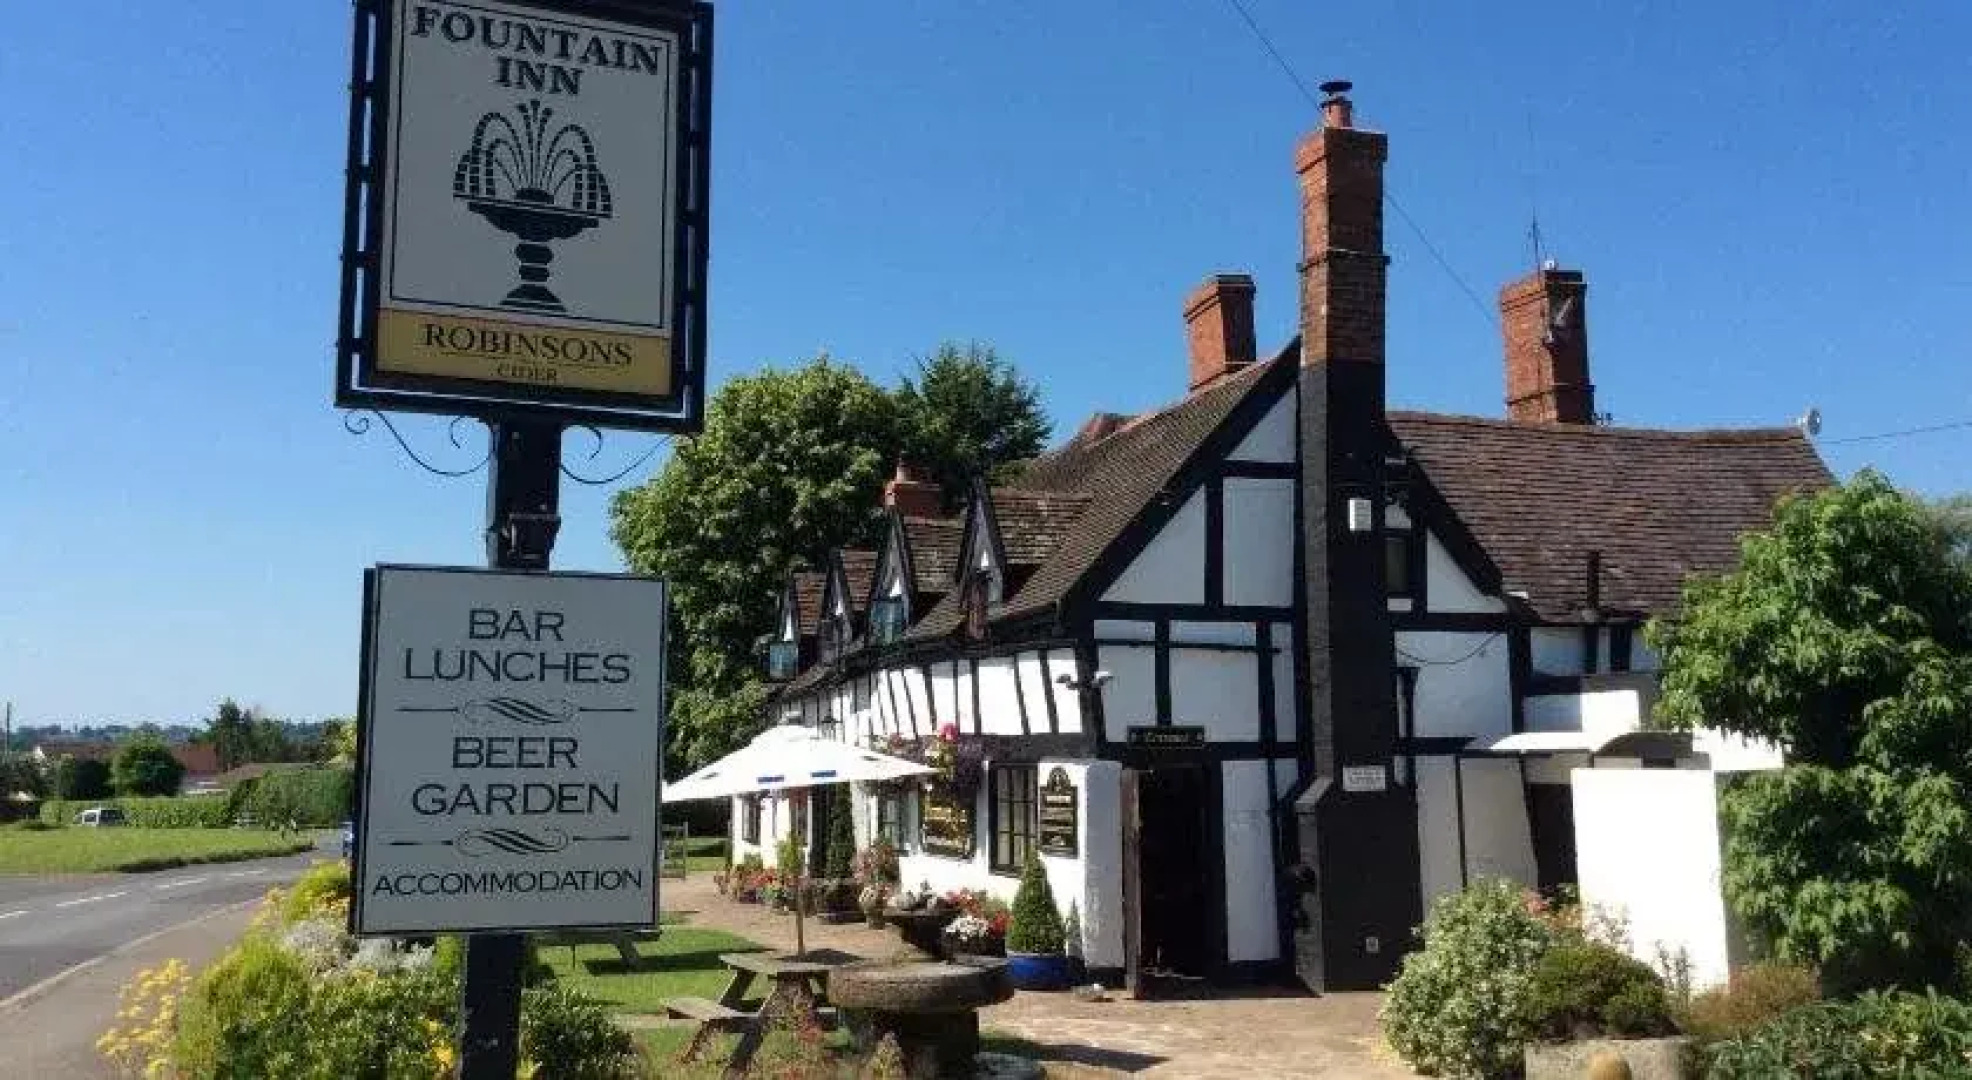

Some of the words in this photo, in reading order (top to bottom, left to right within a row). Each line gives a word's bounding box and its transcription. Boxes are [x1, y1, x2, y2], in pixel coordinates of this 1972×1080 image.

[411, 6, 663, 75] FOUNTAIN
[495, 56, 584, 95] INN
[423, 323, 634, 366] ROBINSONS
[497, 361, 558, 384] CIDER
[468, 608, 566, 642] BAR
[404, 648, 632, 684] LUNCHES
[452, 736, 580, 769] BEER
[411, 782, 619, 816] GARDEN
[372, 869, 643, 896] ACCOMMODATION
